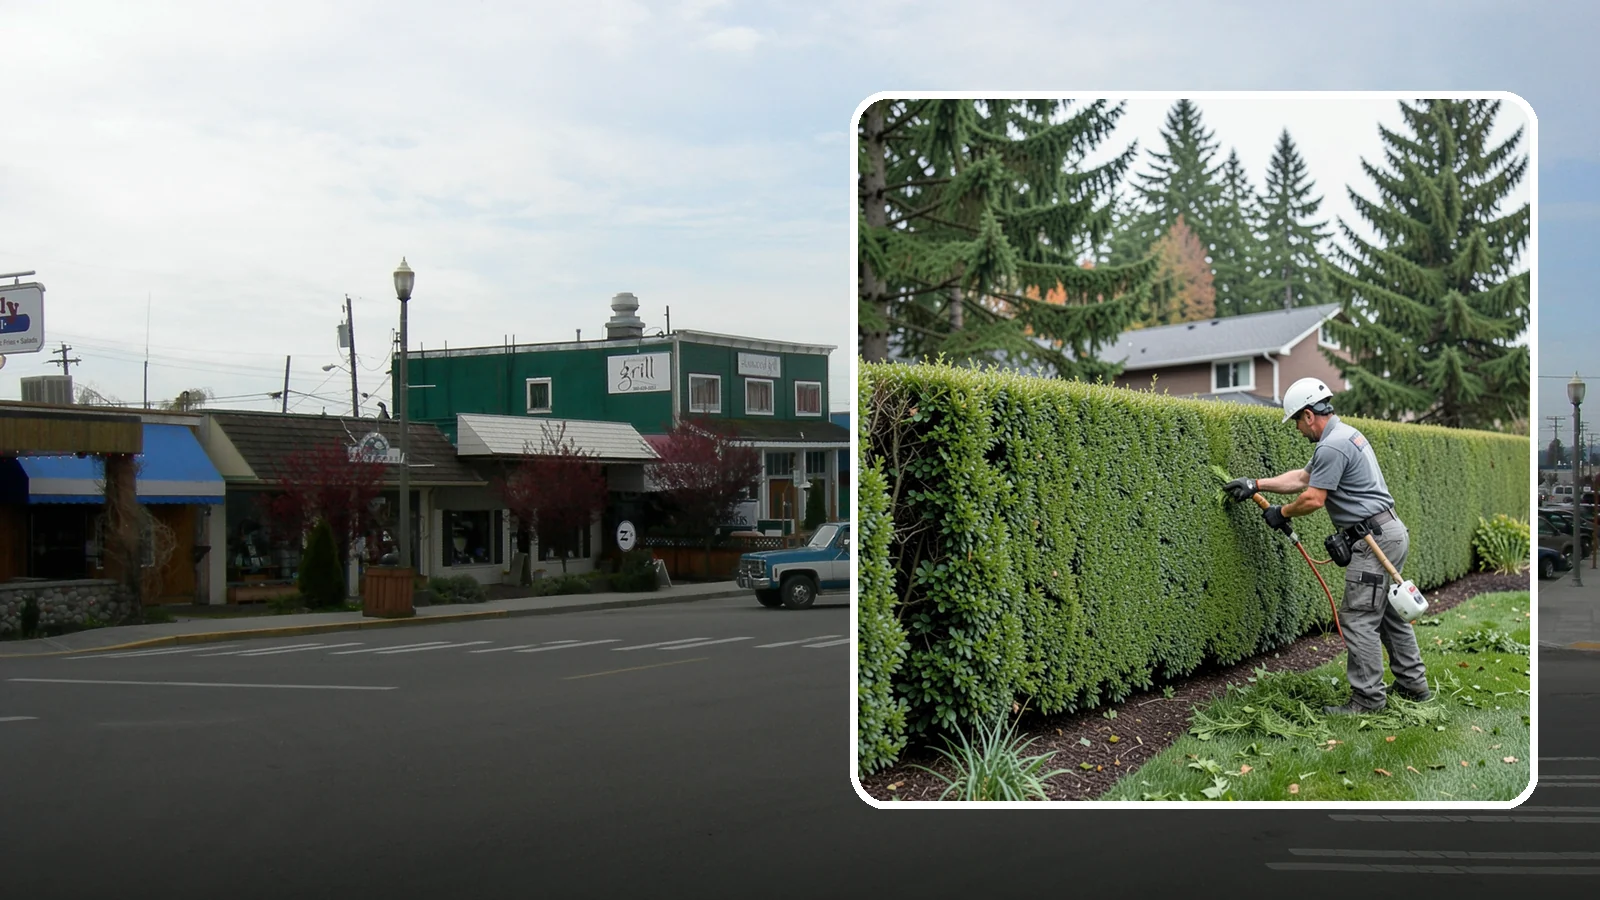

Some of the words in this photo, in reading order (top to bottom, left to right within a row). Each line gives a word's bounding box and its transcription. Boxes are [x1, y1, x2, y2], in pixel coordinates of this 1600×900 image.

[3, 338, 16, 346] Fries
[20, 337, 38, 345] Salads
[618, 356, 654, 392] grill
